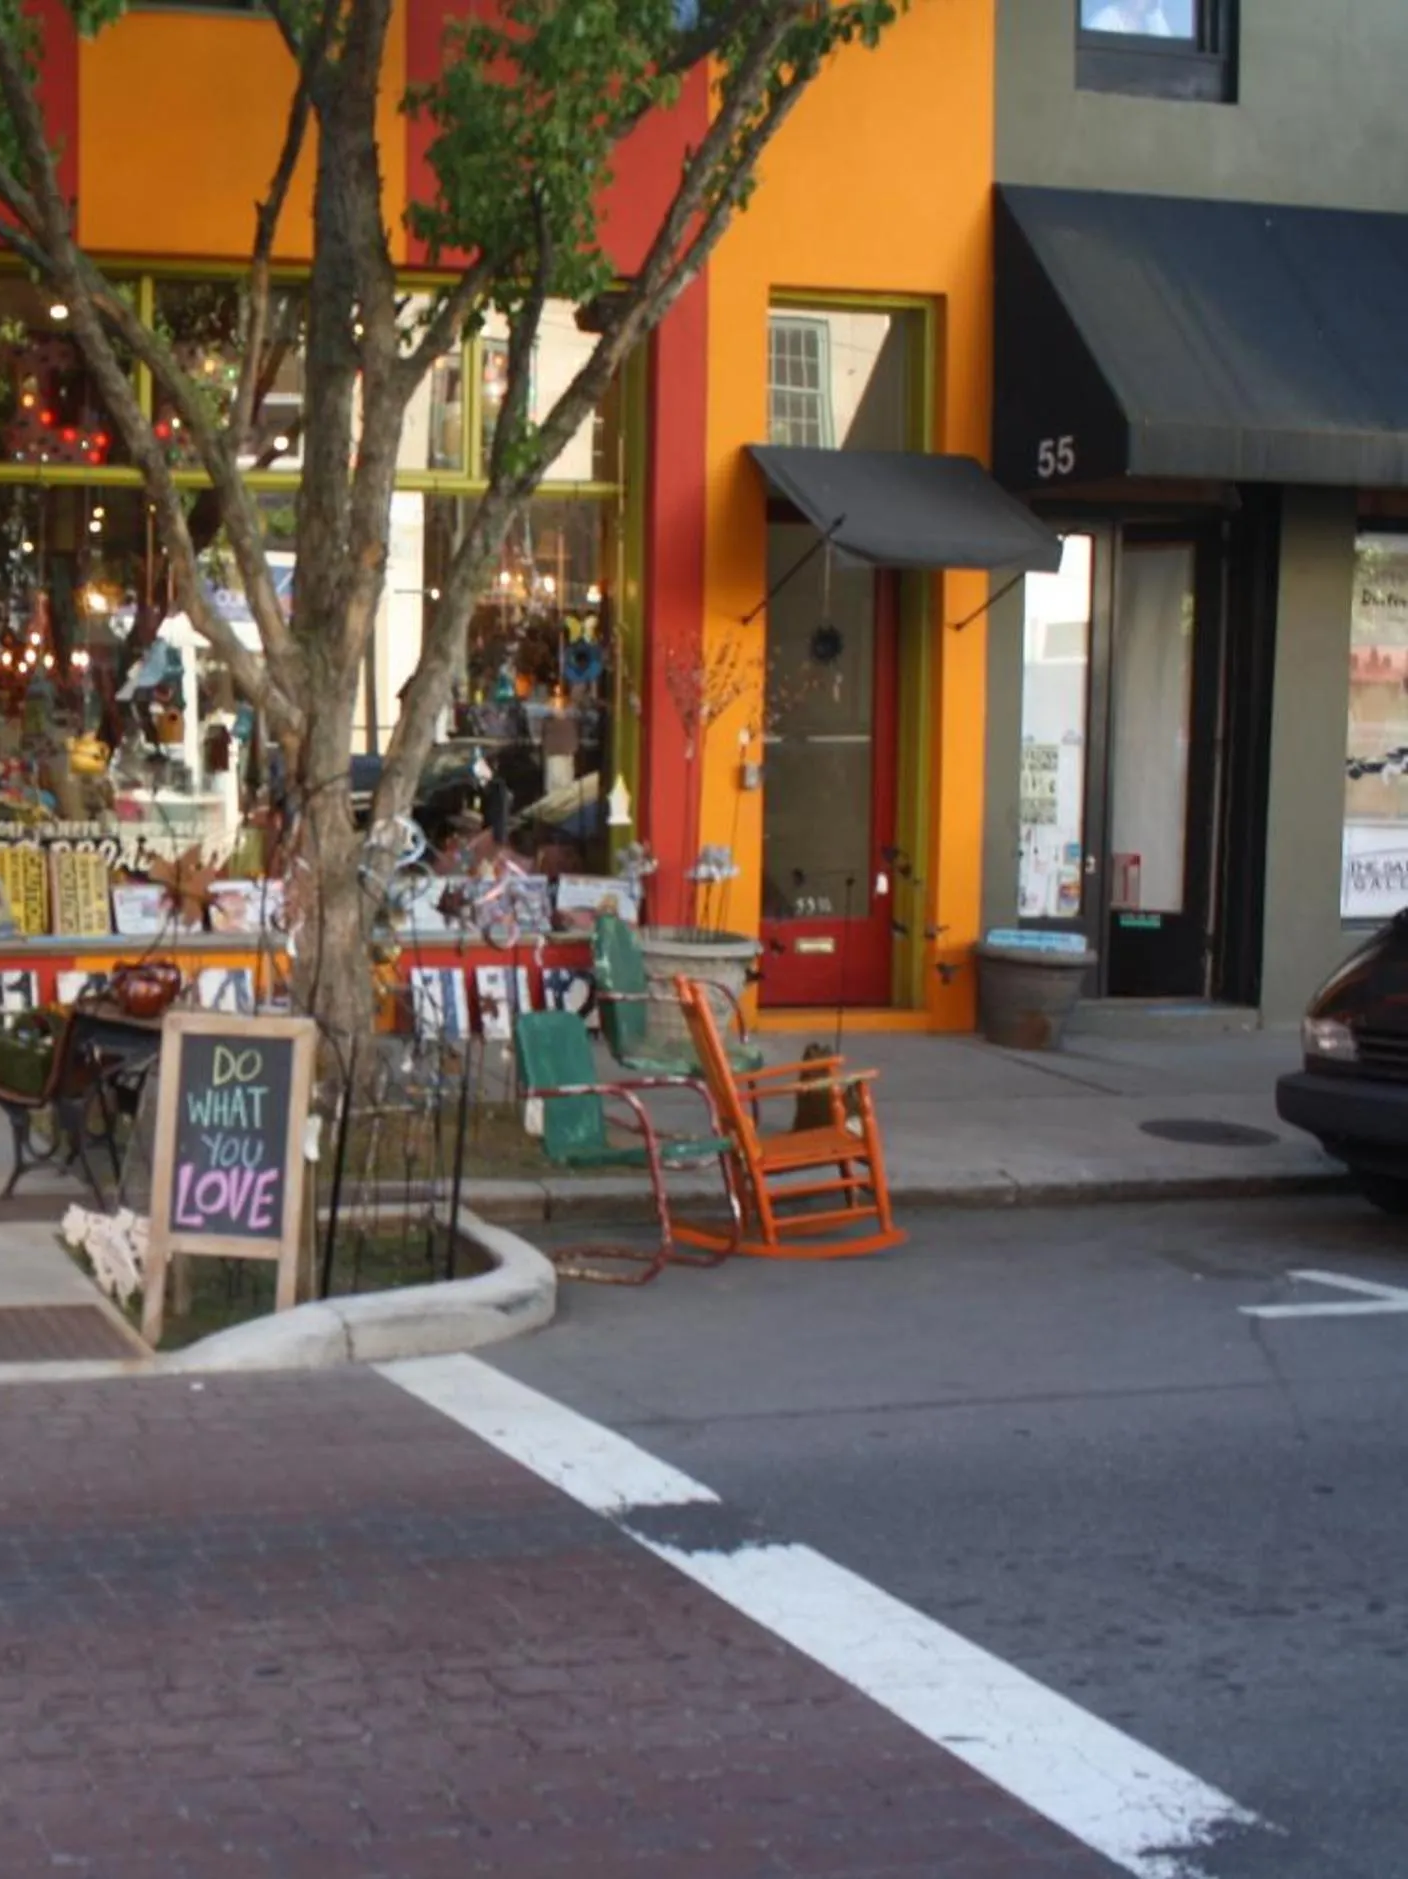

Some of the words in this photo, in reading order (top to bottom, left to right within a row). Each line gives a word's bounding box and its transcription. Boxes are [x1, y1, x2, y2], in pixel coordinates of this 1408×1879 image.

[1038, 435, 1074, 477] 55
[212, 1046, 262, 1086] DO
[188, 1086, 268, 1128] WHAT
[201, 1132, 265, 1169] YOU
[175, 1164, 279, 1230] LOVE
